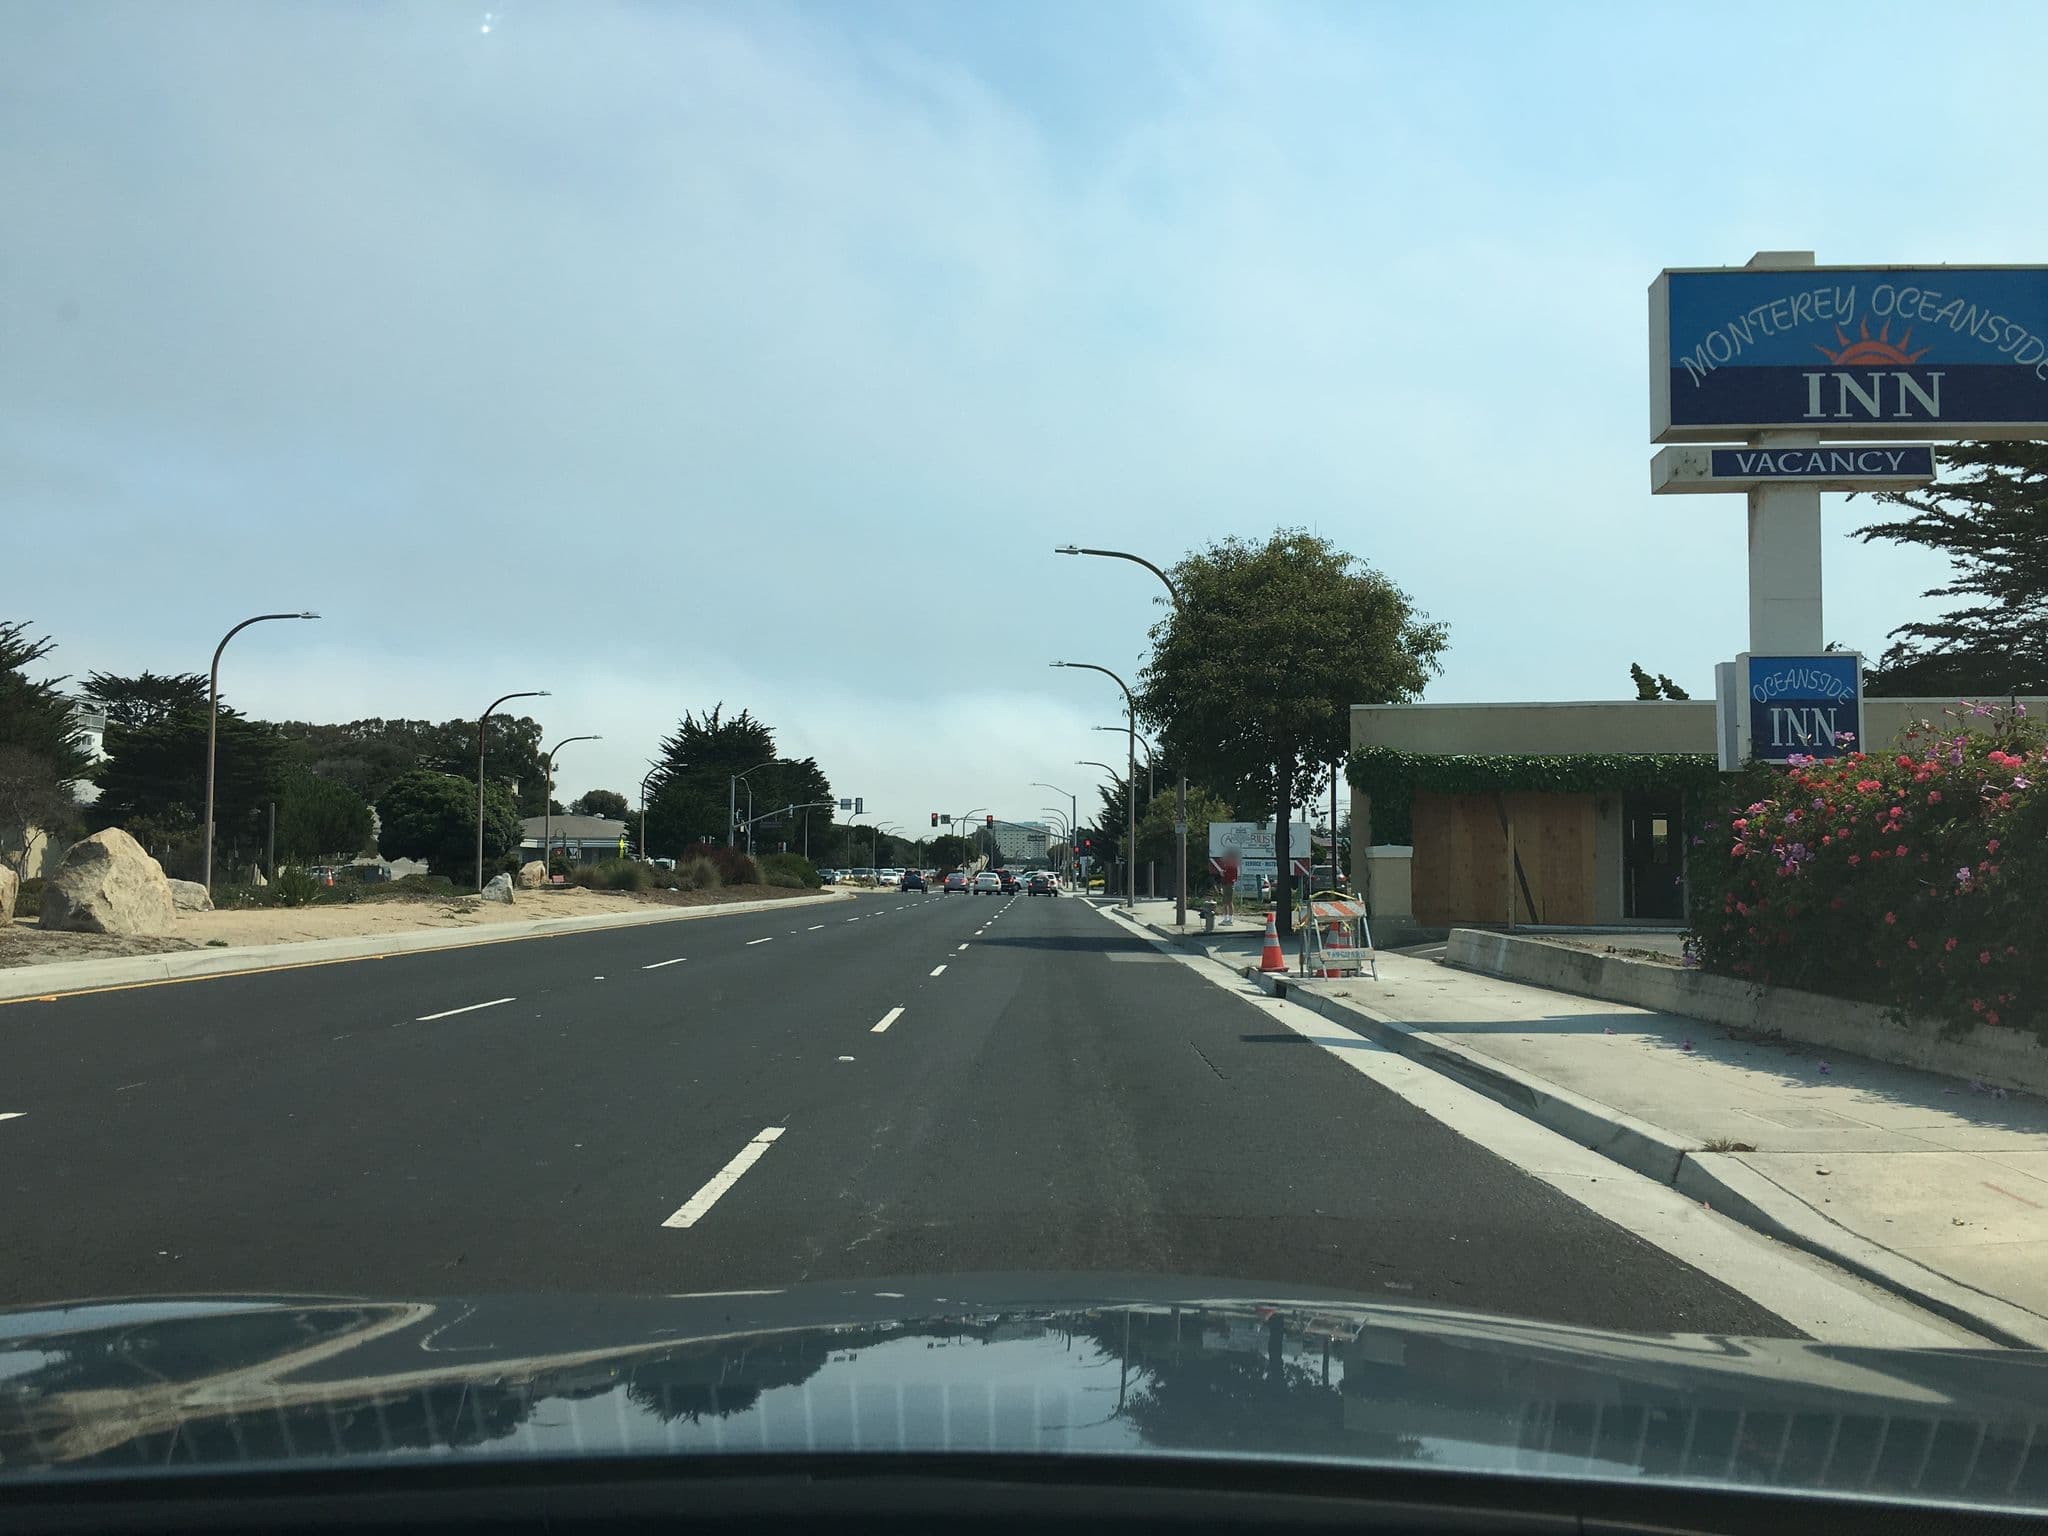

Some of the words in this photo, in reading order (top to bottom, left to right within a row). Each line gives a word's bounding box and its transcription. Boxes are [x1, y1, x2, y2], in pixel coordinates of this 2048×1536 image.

[1680, 285, 1857, 388] MONTEREY
[1802, 371, 1946, 419] INN
[1735, 450, 1906, 475] VACANCY
[1752, 668, 1856, 706] OCEANSIDE
[1770, 707, 1837, 747] INN
